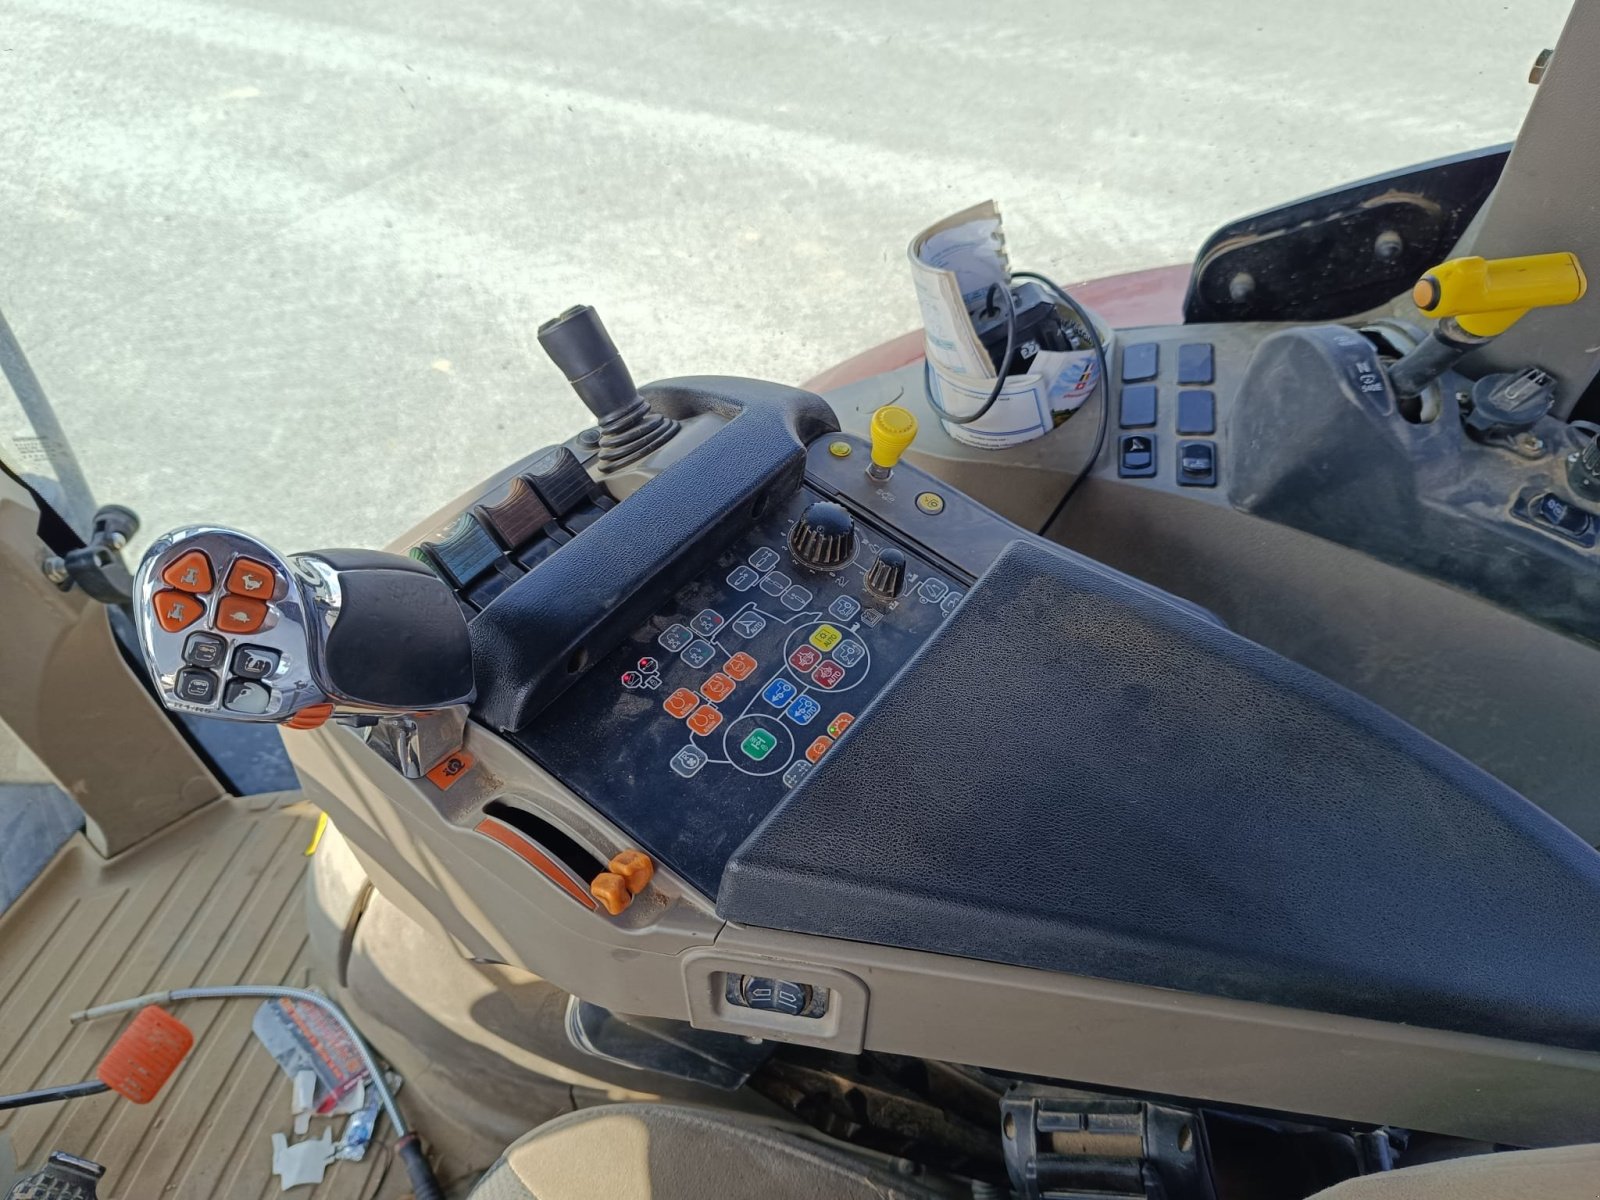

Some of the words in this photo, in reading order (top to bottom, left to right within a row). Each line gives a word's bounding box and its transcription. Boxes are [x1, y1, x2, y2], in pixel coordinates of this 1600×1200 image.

[750, 621, 763, 634] AUTO
[824, 634, 838, 647] AUTO
[828, 670, 842, 685] AUTO
[803, 707, 817, 721] AUTO
